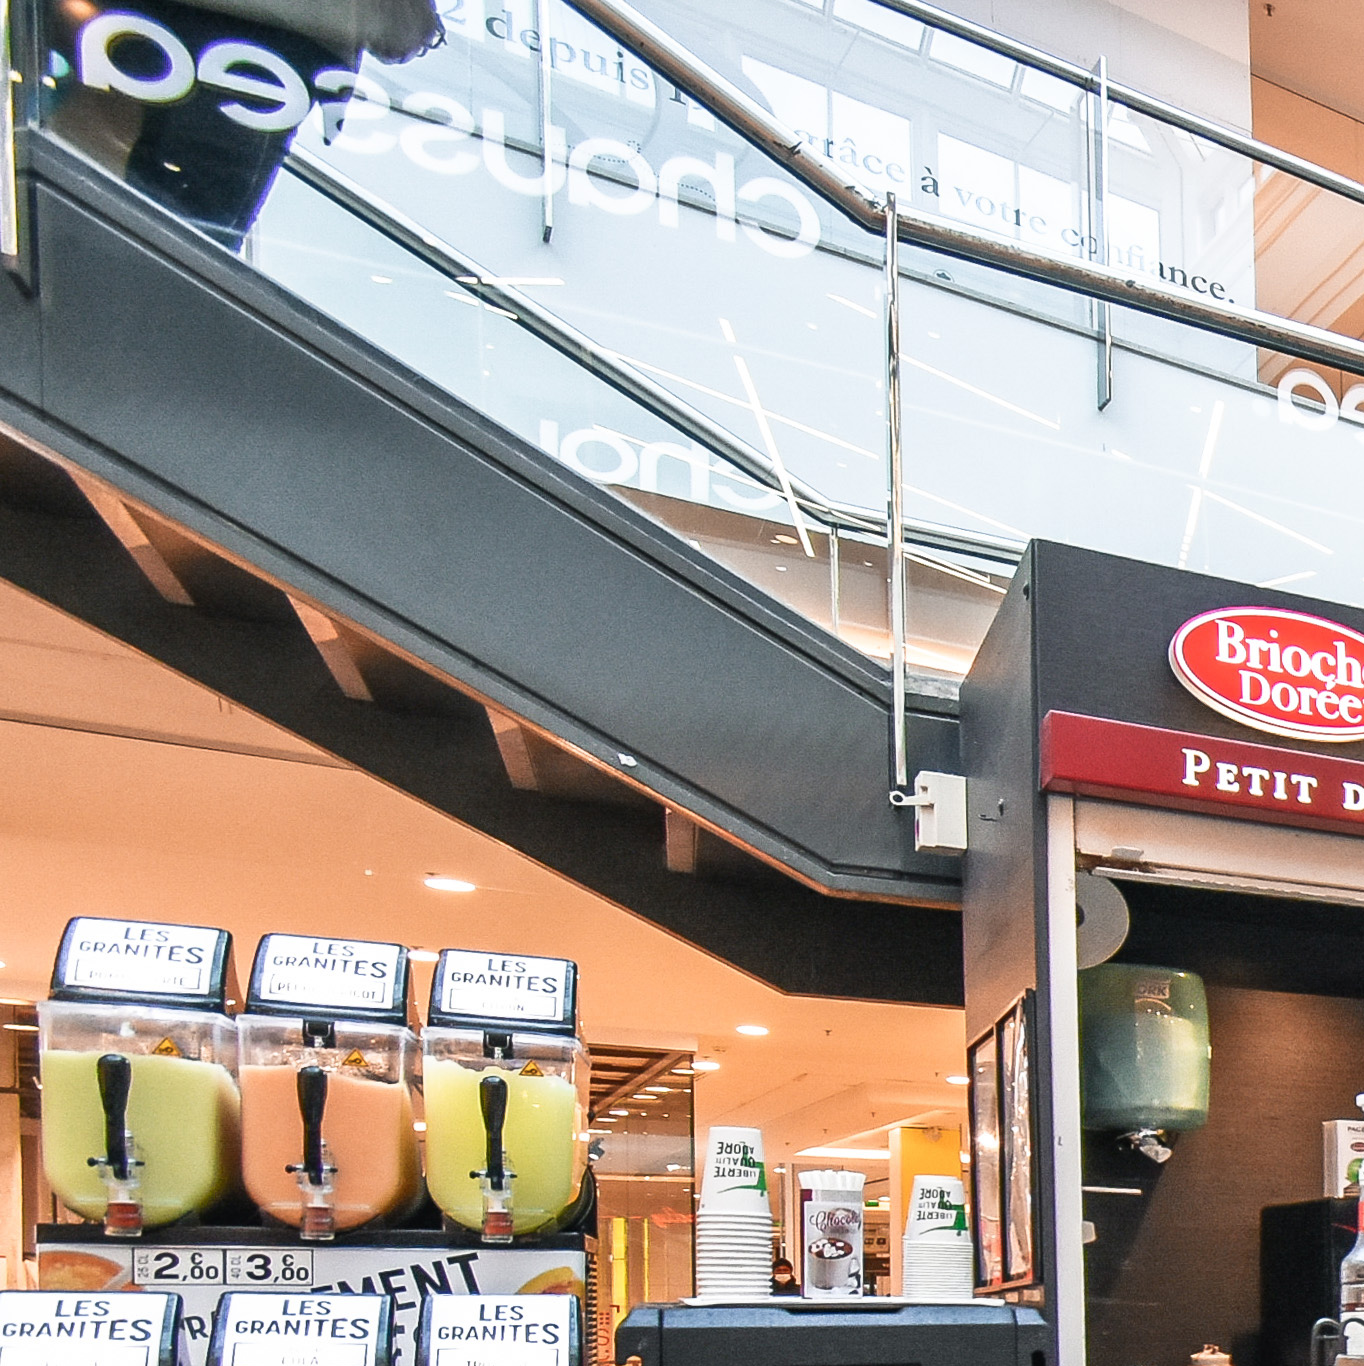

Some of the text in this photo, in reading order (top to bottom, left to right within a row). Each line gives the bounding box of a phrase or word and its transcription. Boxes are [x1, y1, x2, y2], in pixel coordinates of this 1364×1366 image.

[485, 9, 649, 90] depuis
[921, 166, 940, 197] à
[1239, 670, 1364, 724] Dorée
[1182, 748, 1318, 805] PETIT
[124, 927, 170, 942] LES
[313, 942, 354, 957] LES
[488, 958, 526, 973] LES
[55, 1300, 110, 1317] LES
[282, 1299, 331, 1316] LES
[479, 1304, 524, 1321] LES
